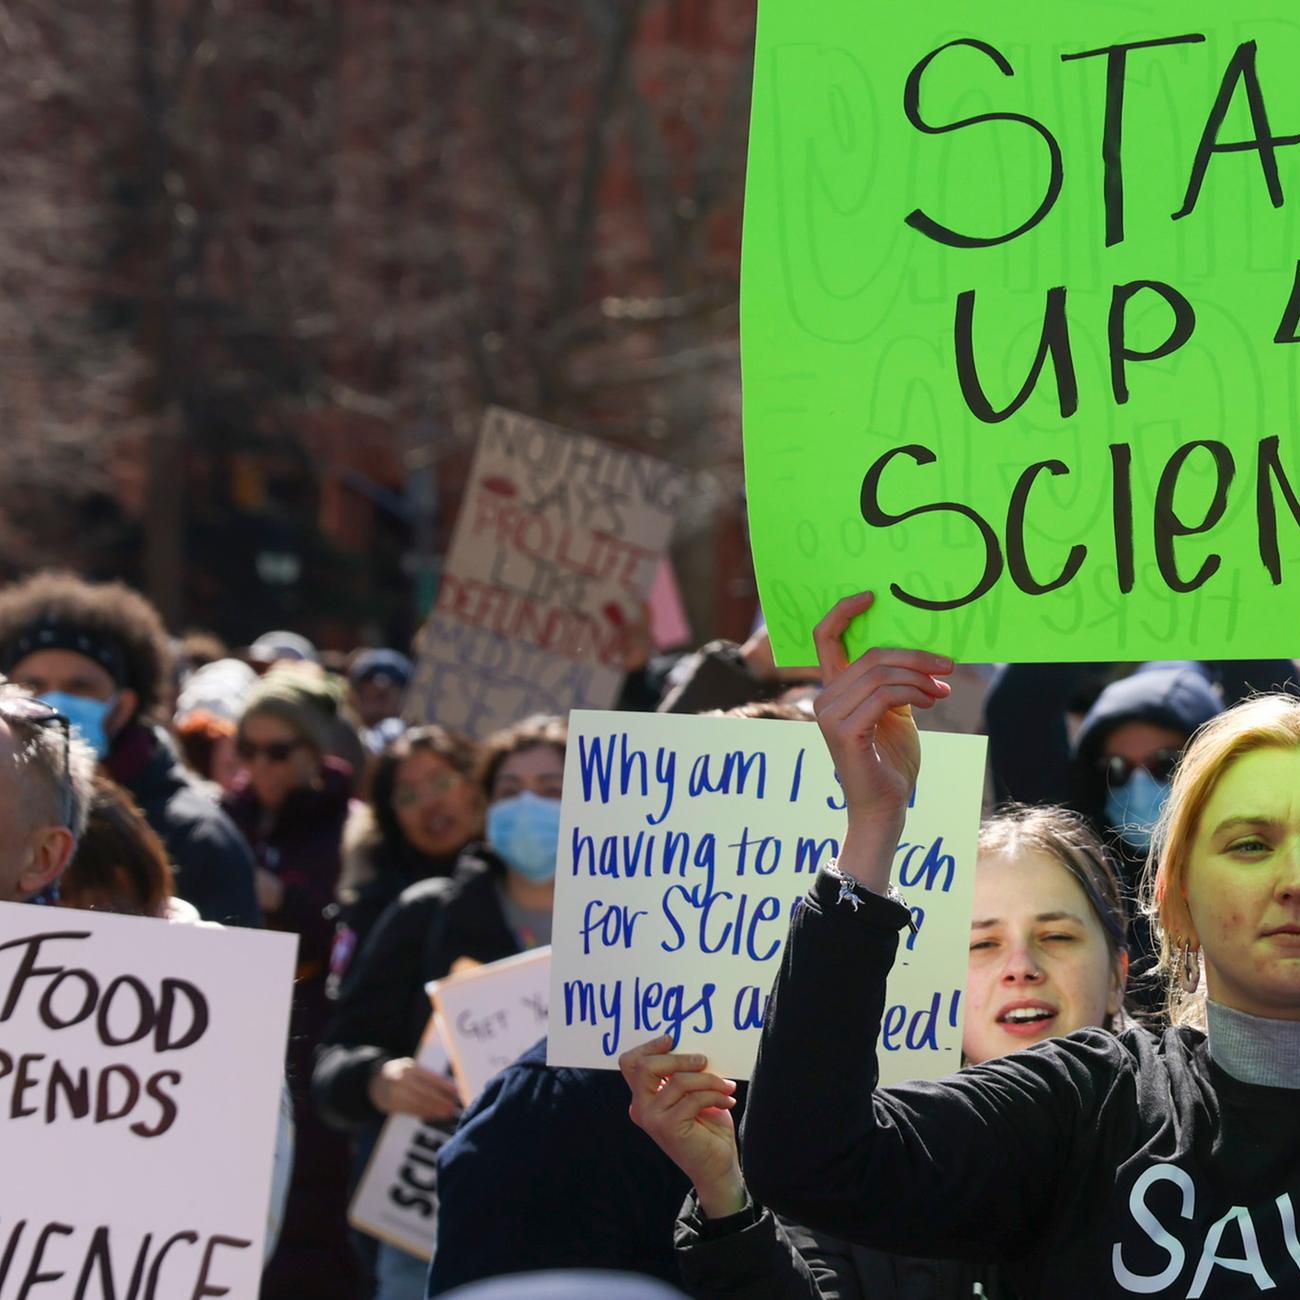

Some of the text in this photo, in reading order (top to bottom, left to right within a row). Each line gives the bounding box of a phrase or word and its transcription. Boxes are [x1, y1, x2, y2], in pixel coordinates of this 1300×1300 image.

[578, 733, 677, 826] Why
[689, 751, 767, 800] am
[572, 827, 717, 909] having
[728, 827, 782, 876] to
[579, 900, 649, 955] for
[0, 931, 210, 1053] FOOD
[564, 979, 623, 1056] my
[634, 977, 717, 1052] legs
[882, 989, 962, 1051] ed!
